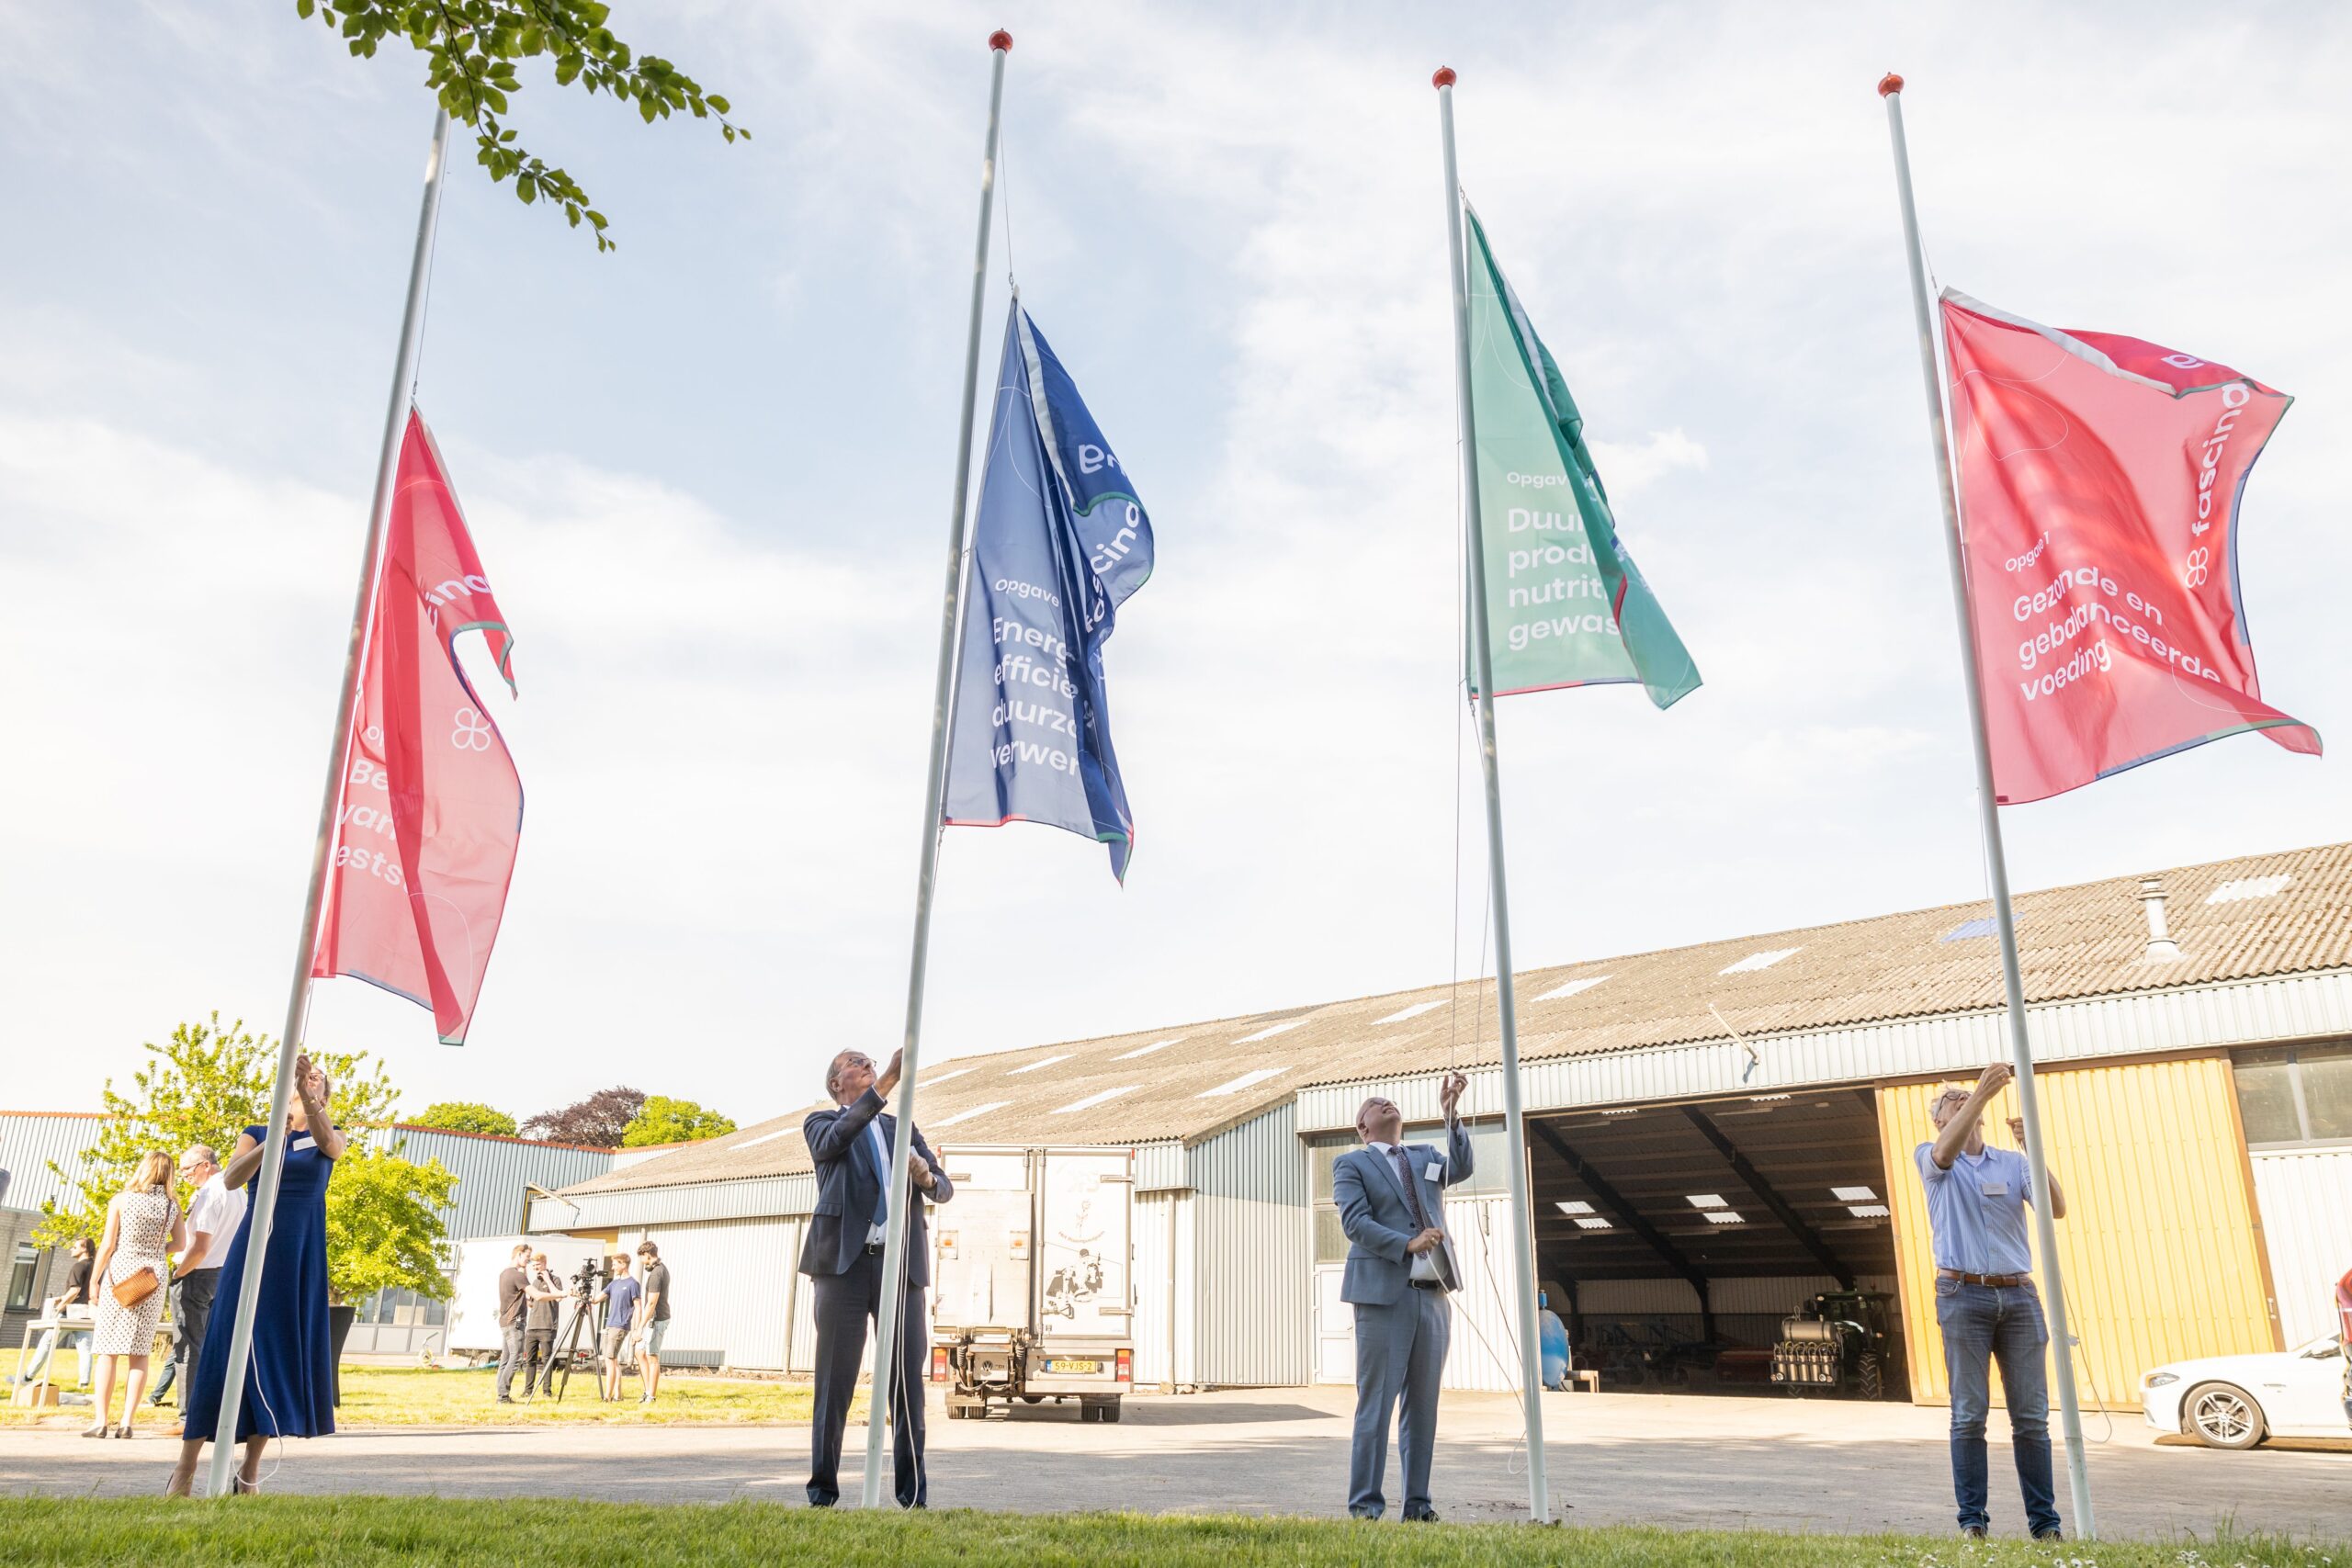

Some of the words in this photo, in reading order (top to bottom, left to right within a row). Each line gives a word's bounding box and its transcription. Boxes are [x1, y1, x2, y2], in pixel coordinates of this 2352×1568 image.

[2192, 383, 2249, 536] fascina
[2043, 530, 2050, 545] 1
[1509, 544, 1597, 579] prod
[1509, 574, 1608, 607] nutrit
[2014, 566, 2118, 622] Gezonde
[2126, 592, 2162, 626] en
[1509, 615, 1620, 650] gewas
[2019, 603, 2221, 682] gebalanceerde
[2020, 638, 2111, 701] voeding
[336, 845, 408, 893] ests
[1055, 1362, 1092, 1371] 59-VJS-2
